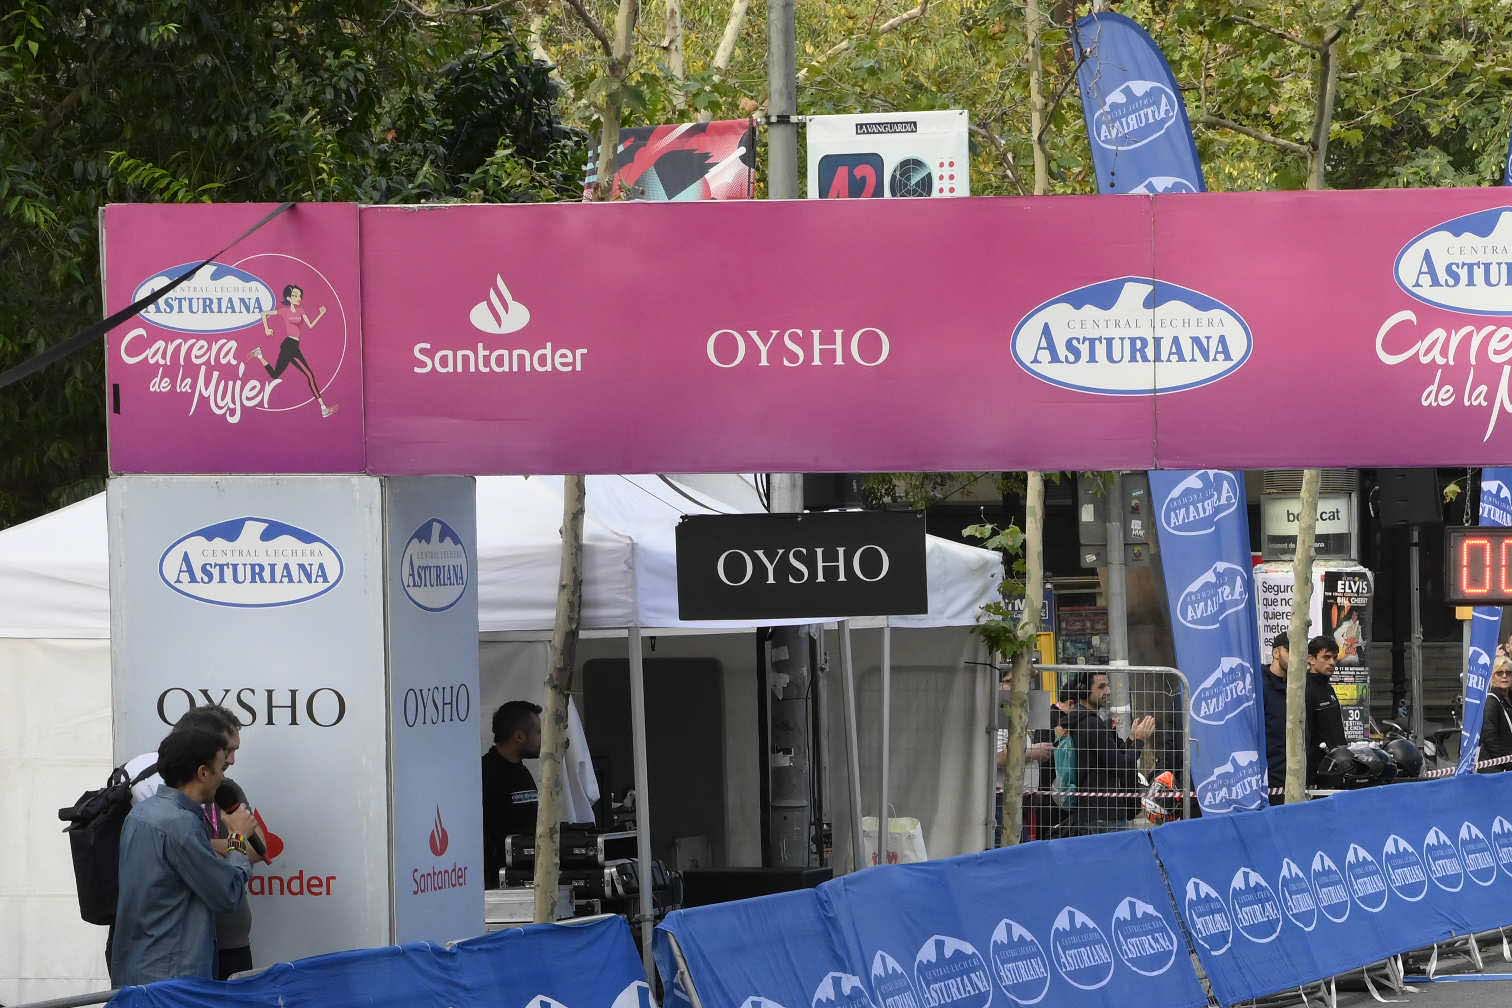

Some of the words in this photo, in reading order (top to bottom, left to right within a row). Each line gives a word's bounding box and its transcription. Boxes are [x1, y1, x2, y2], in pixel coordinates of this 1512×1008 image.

[867, 122, 917, 134] VANGUARDIA
[144, 288, 264, 315] ASTURIANA
[171, 285, 210, 294] ENTRAL
[1066, 318, 1147, 331] CENTRAL
[1149, 316, 1226, 329] LECHERA
[120, 327, 239, 365] Carrera
[413, 342, 588, 374] Santander
[706, 327, 891, 369] OYSHO
[1030, 320, 1235, 365] ASTURIANA
[149, 367, 172, 393] de
[176, 364, 192, 393] la
[188, 362, 284, 424] Mujer
[1420, 369, 1456, 407] de
[1463, 367, 1488, 407] la
[1287, 508, 1341, 523] b.cat
[174, 551, 330, 586] ASTURIANA
[201, 549, 259, 558] CENTRAL
[265, 548, 324, 558] LECHERA
[717, 544, 890, 586] OYSHO
[406, 553, 465, 588] ASTURIANA
[1337, 580, 1368, 594] ELVIS
[1262, 598, 1279, 612] que
[157, 686, 347, 729] OYSHO
[403, 683, 470, 729] OYSHO
[1348, 709, 1360, 721] 30
[246, 870, 337, 896] ander
[412, 862, 468, 896] Santander
